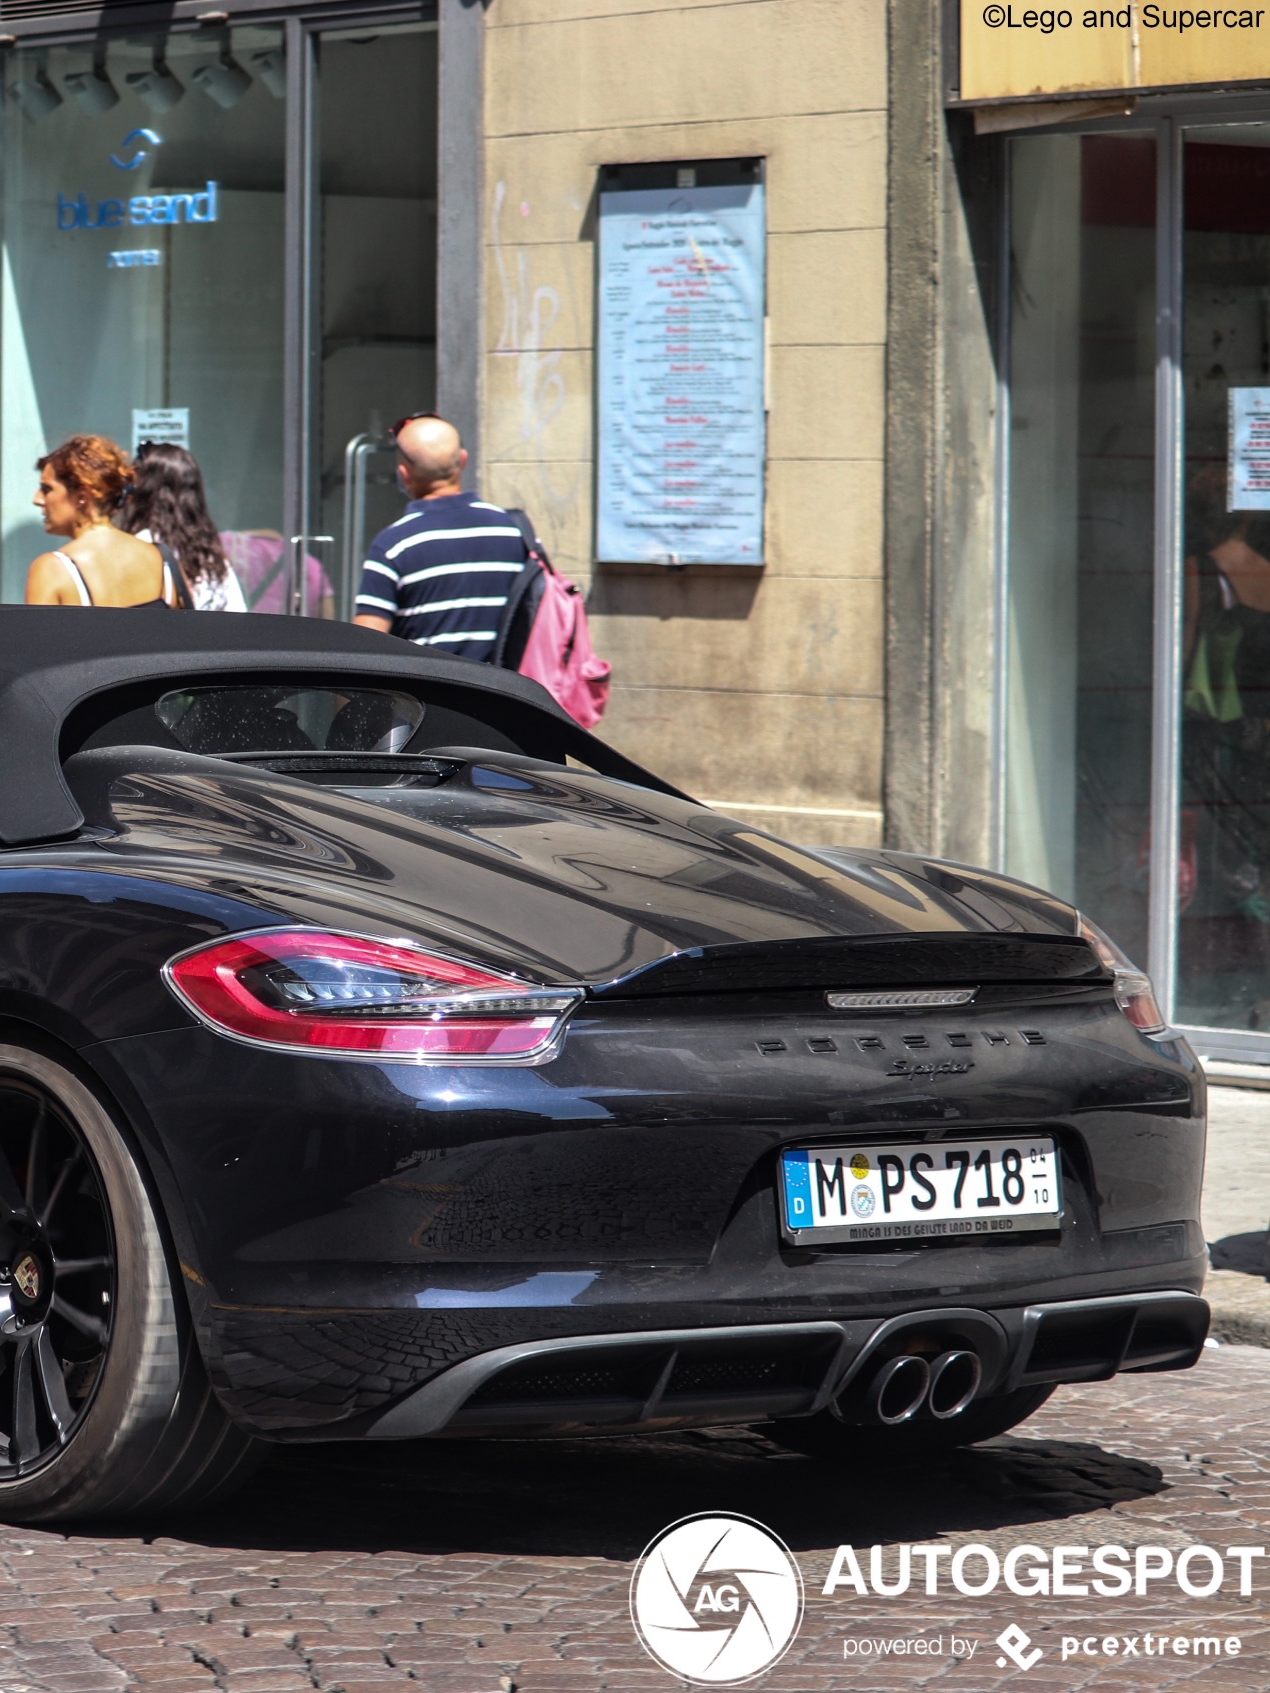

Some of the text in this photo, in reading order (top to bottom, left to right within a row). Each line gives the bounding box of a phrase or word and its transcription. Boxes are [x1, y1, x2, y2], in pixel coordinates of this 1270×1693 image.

[57, 180, 217, 231] blue sand
[755, 1030, 1047, 1056] PORSCHE
[885, 1060, 975, 1082] Spyder
[814, 1157, 847, 1217] M
[794, 1197, 806, 1215] D
[849, 1226, 880, 1240] MINGA
[884, 1226, 892, 1237] IS
[894, 1225, 912, 1237] DES
[949, 1221, 973, 1233] LAND
[975, 1220, 988, 1232] DA
